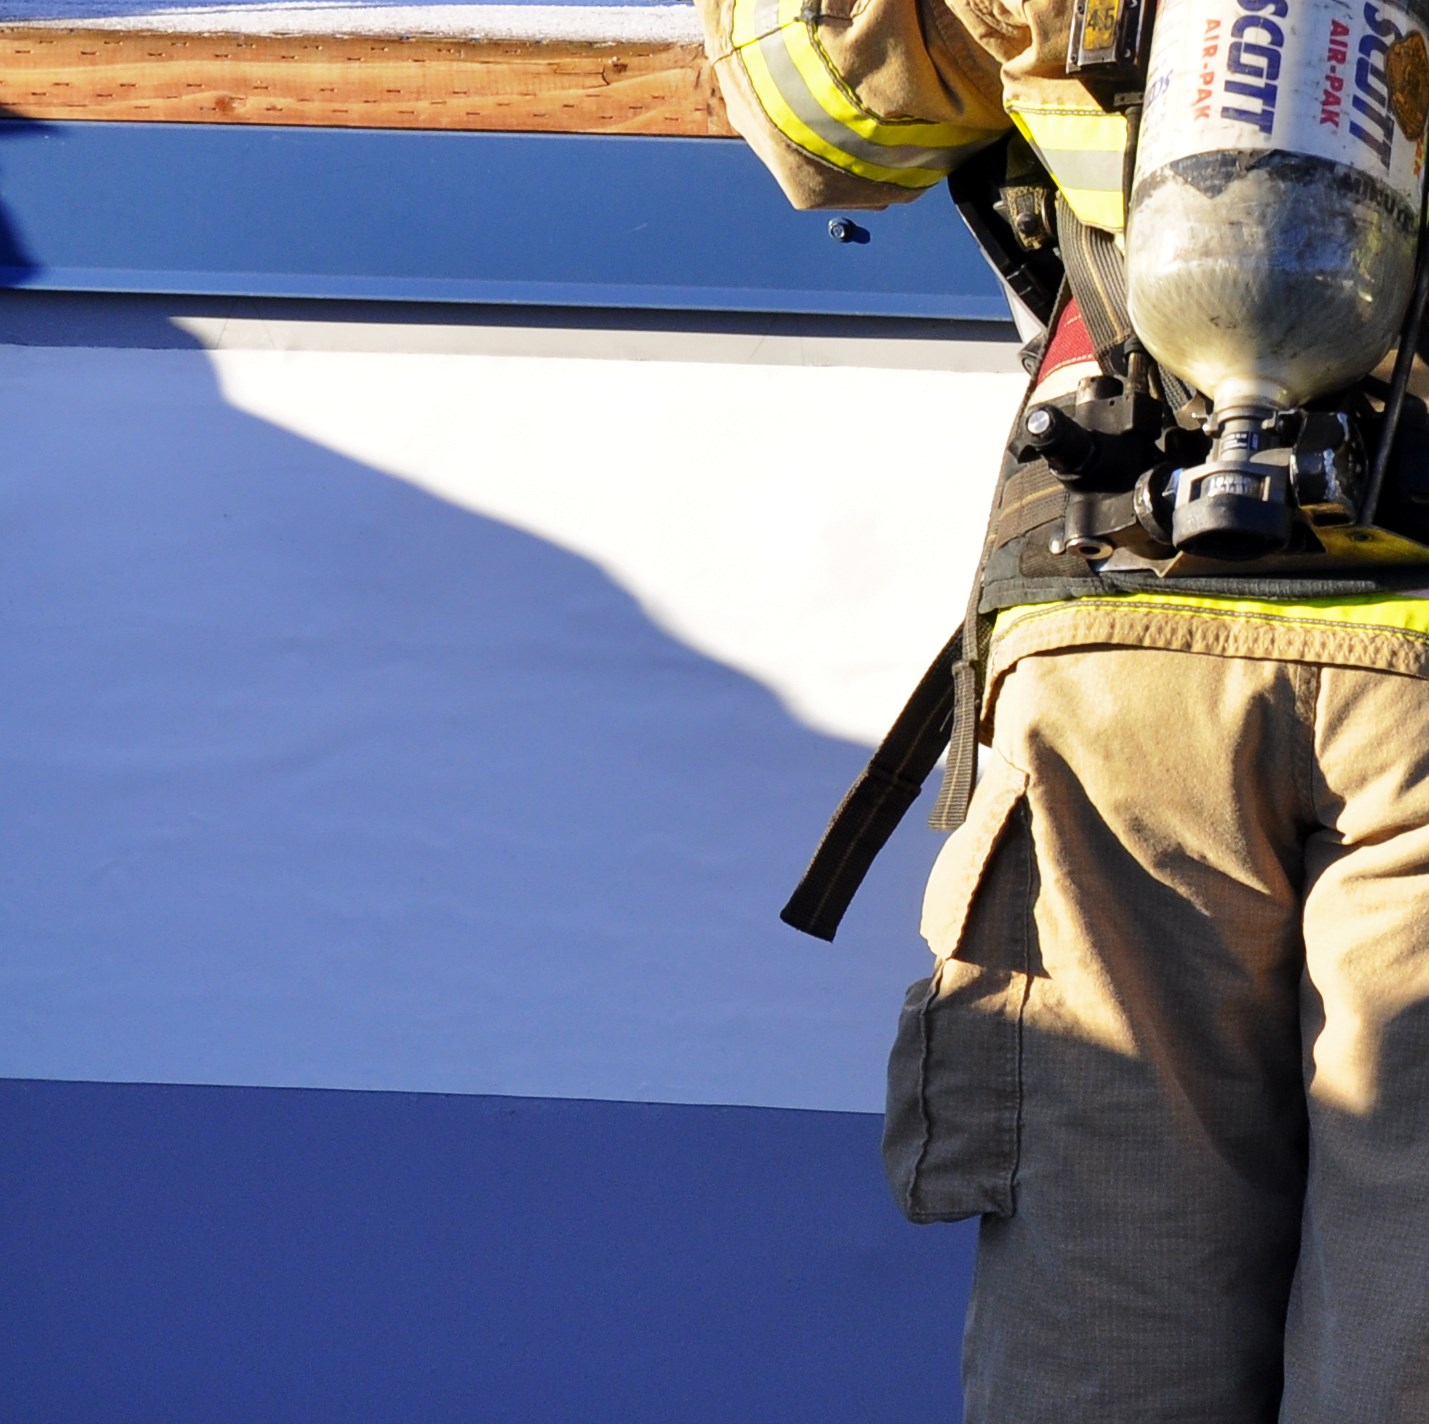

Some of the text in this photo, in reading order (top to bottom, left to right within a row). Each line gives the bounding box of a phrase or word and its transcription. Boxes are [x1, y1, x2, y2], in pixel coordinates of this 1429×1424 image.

[1087, 6, 1115, 33] 4.5
[1190, 17, 1222, 122] AIR-PAK
[1319, 18, 1351, 128] AIR-PAK
